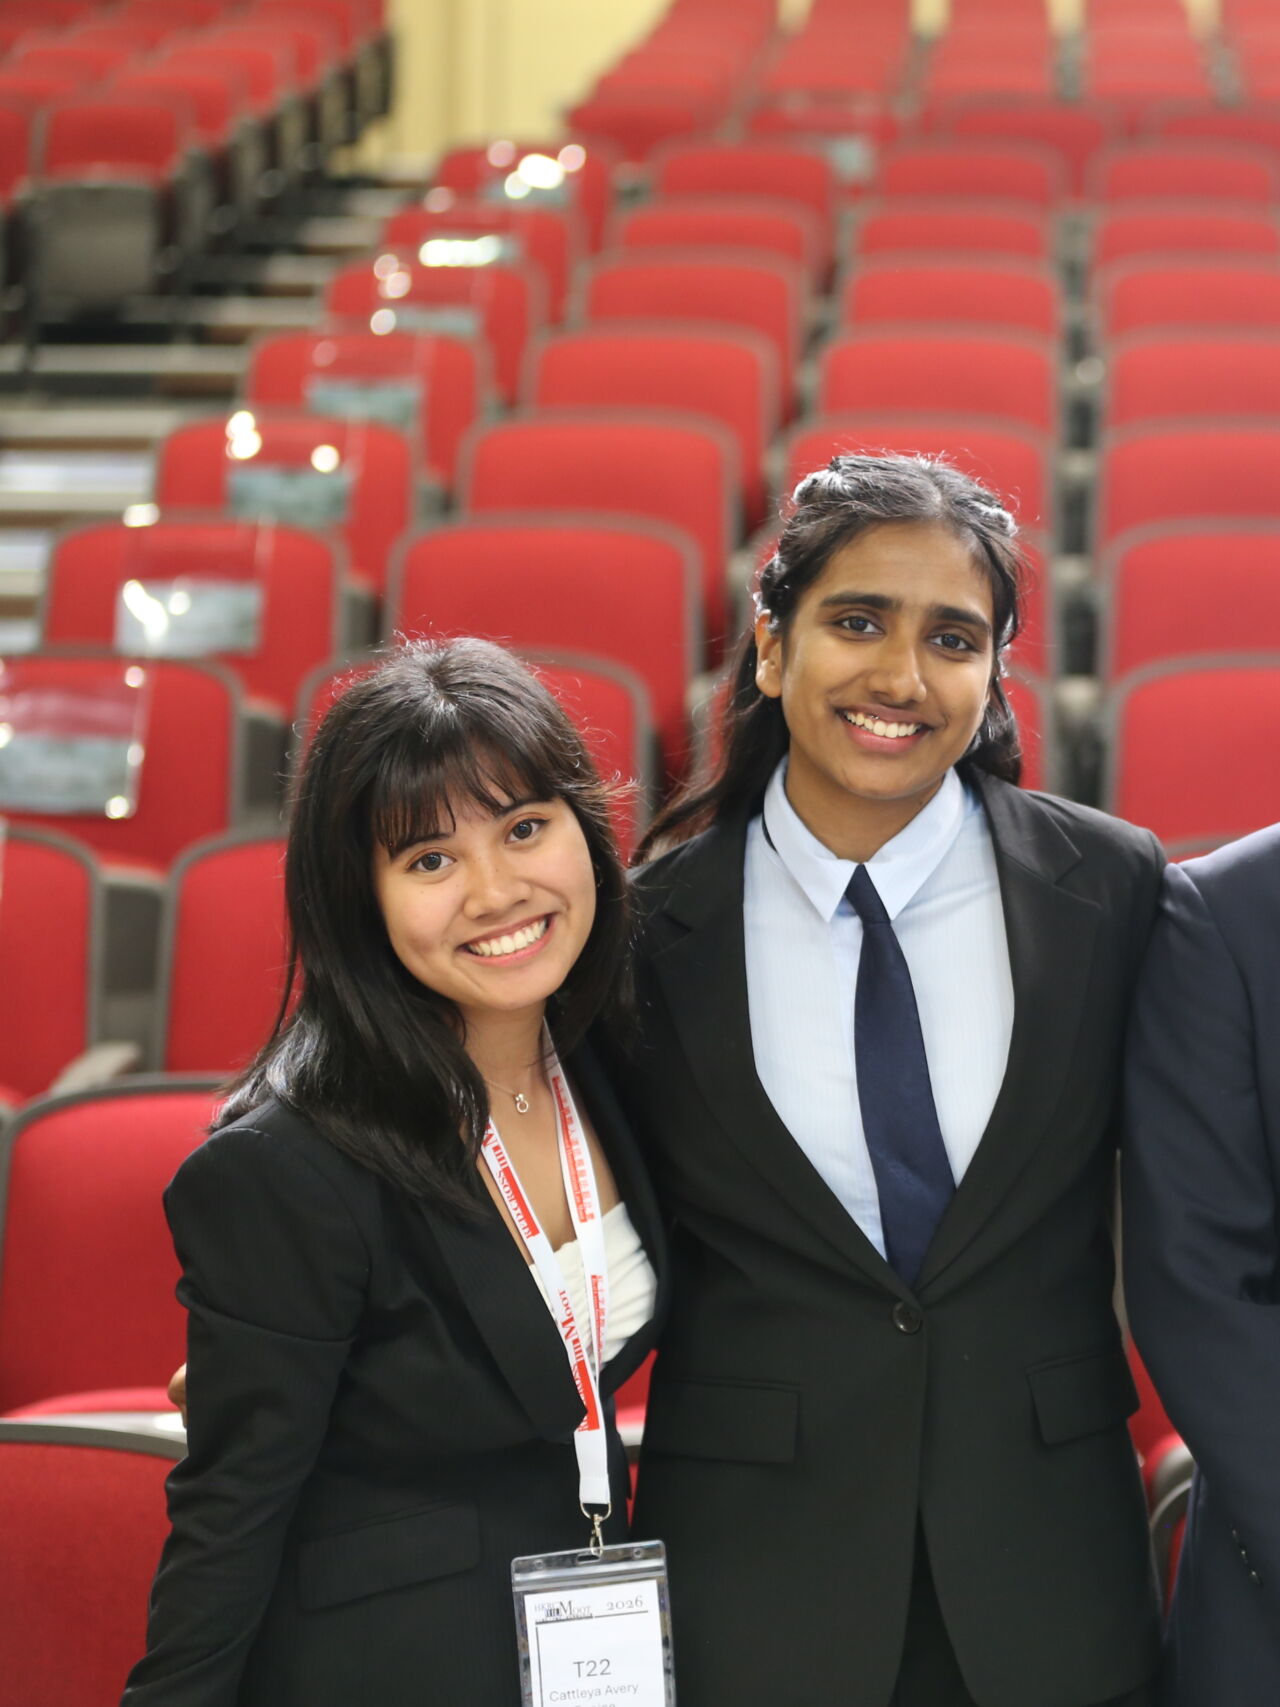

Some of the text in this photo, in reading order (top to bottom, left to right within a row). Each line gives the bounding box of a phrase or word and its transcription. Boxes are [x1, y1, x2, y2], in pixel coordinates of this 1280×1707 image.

[606, 1596, 644, 1611] 2026
[573, 1659, 612, 1678] T22
[549, 1684, 639, 1702] Cattleya Avery
